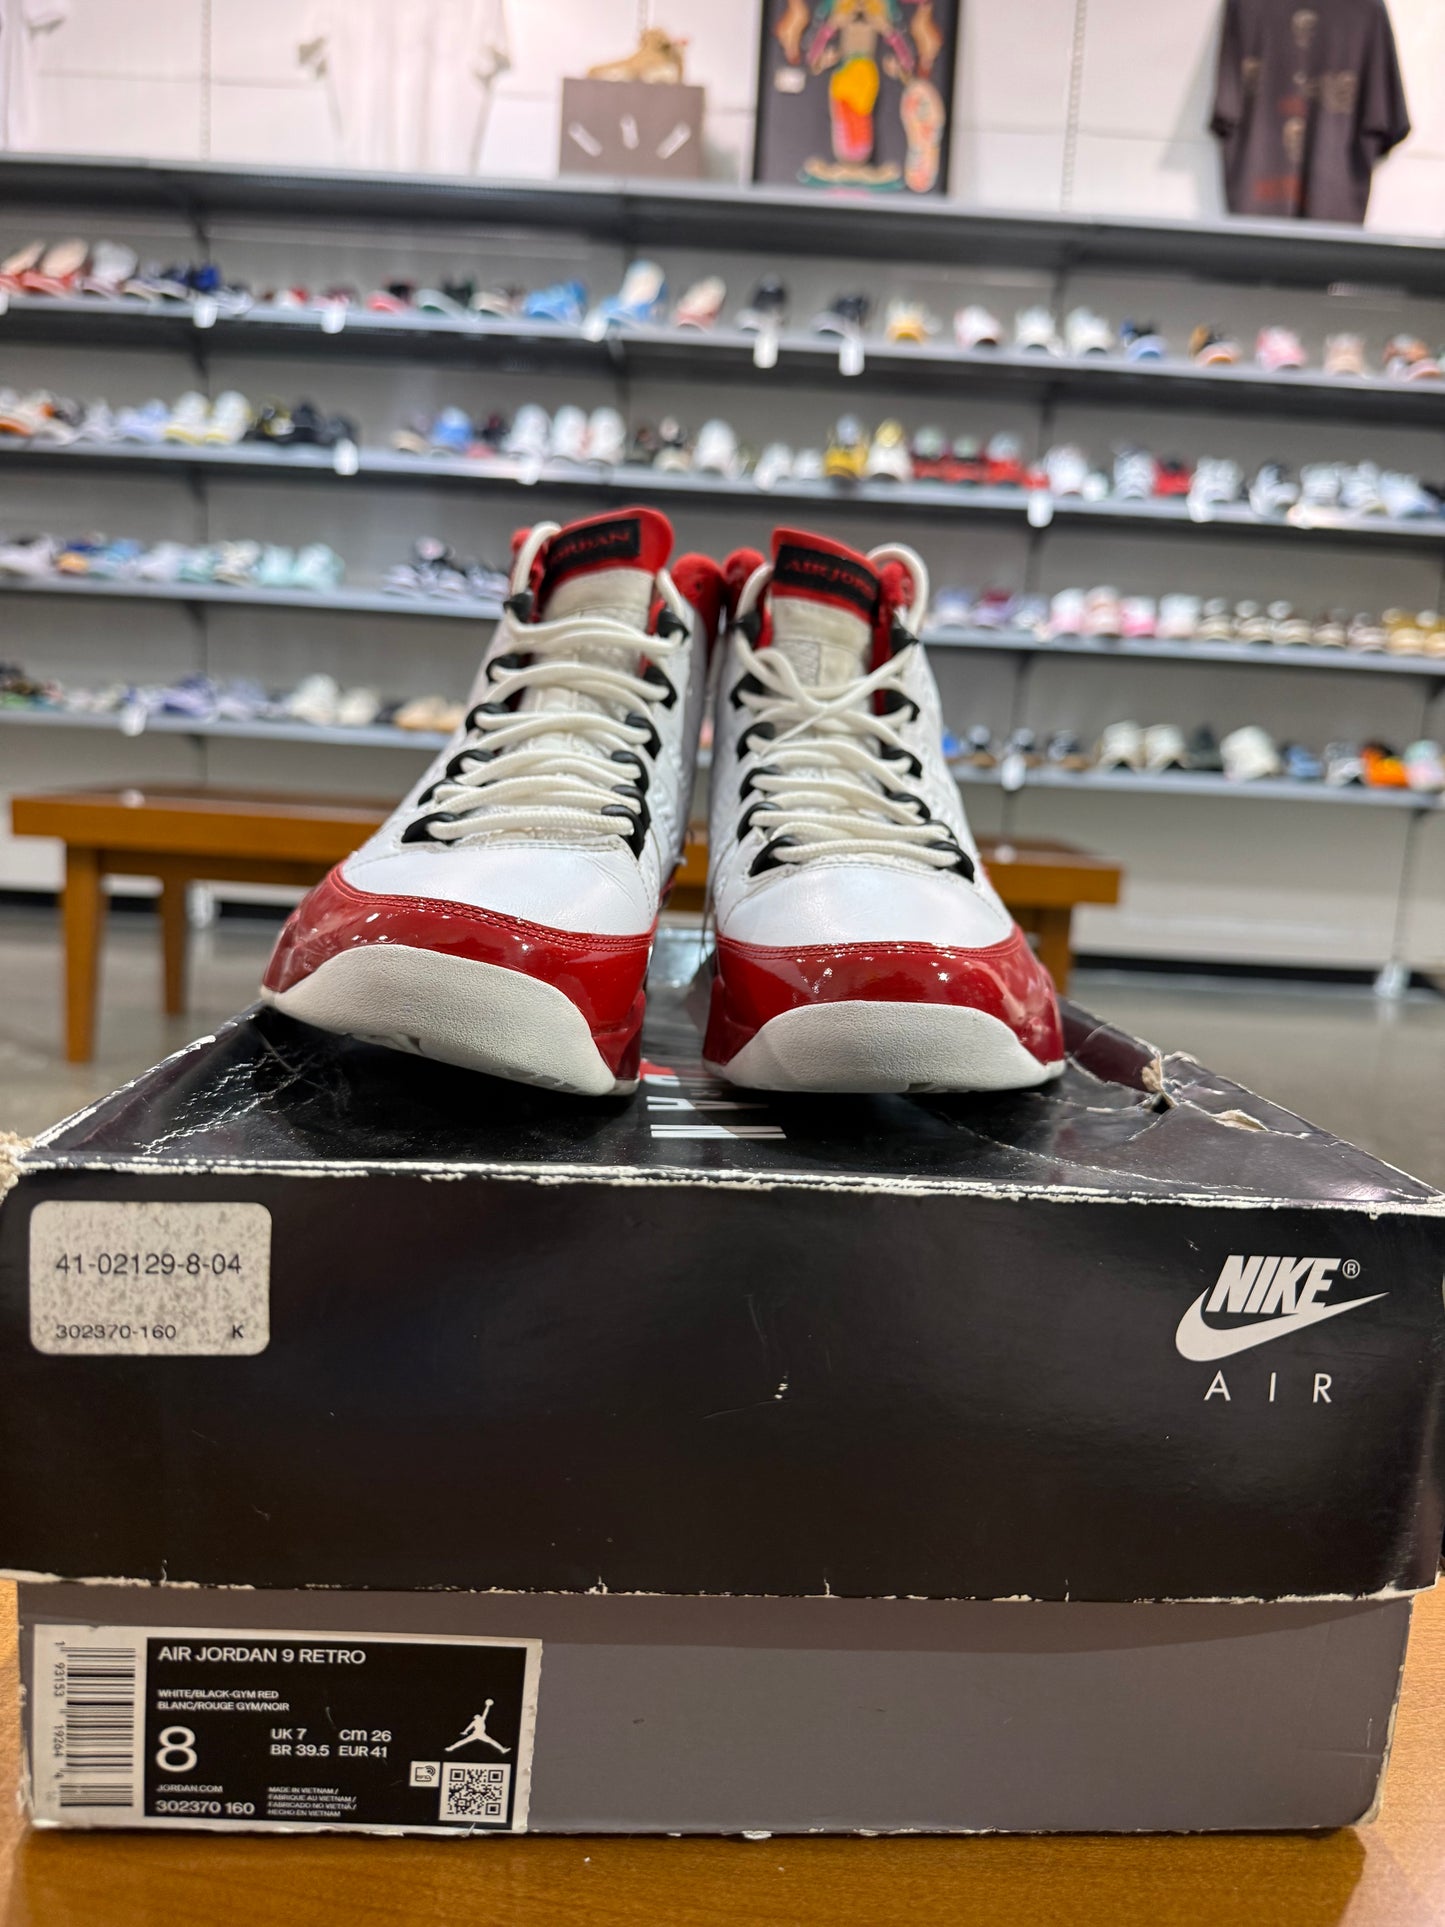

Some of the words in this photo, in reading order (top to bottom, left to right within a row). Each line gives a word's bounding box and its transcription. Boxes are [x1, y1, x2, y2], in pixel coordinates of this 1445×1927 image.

[55, 1253, 242, 1276] 41-02129-8-04
[1205, 1255, 1341, 1315] NIKE
[55, 1324, 177, 1339] 302370-160
[231, 1324, 245, 1339] K
[158, 1646, 192, 1662] AIR
[195, 1647, 278, 1663] JORDAN
[281, 1648, 295, 1663] 9
[298, 1648, 367, 1665] RETRO
[157, 1688, 256, 1699] WHITE/BLACK-GYM
[257, 1690, 280, 1699] RED
[157, 1701, 235, 1711] BLANC/ROUGE
[235, 1702, 290, 1712] GYM/NOIR
[270, 1728, 293, 1741] UK
[296, 1728, 308, 1741] 7
[371, 1729, 392, 1742] 26
[155, 1725, 198, 1773] 8
[270, 1744, 292, 1756] BR
[295, 1745, 330, 1757] 39.5
[338, 1745, 369, 1757] EUR
[370, 1746, 388, 1758] 41
[156, 1784, 224, 1793] JORDAN.COM
[155, 1800, 222, 1814] 302370
[225, 1801, 256, 1815] 160
